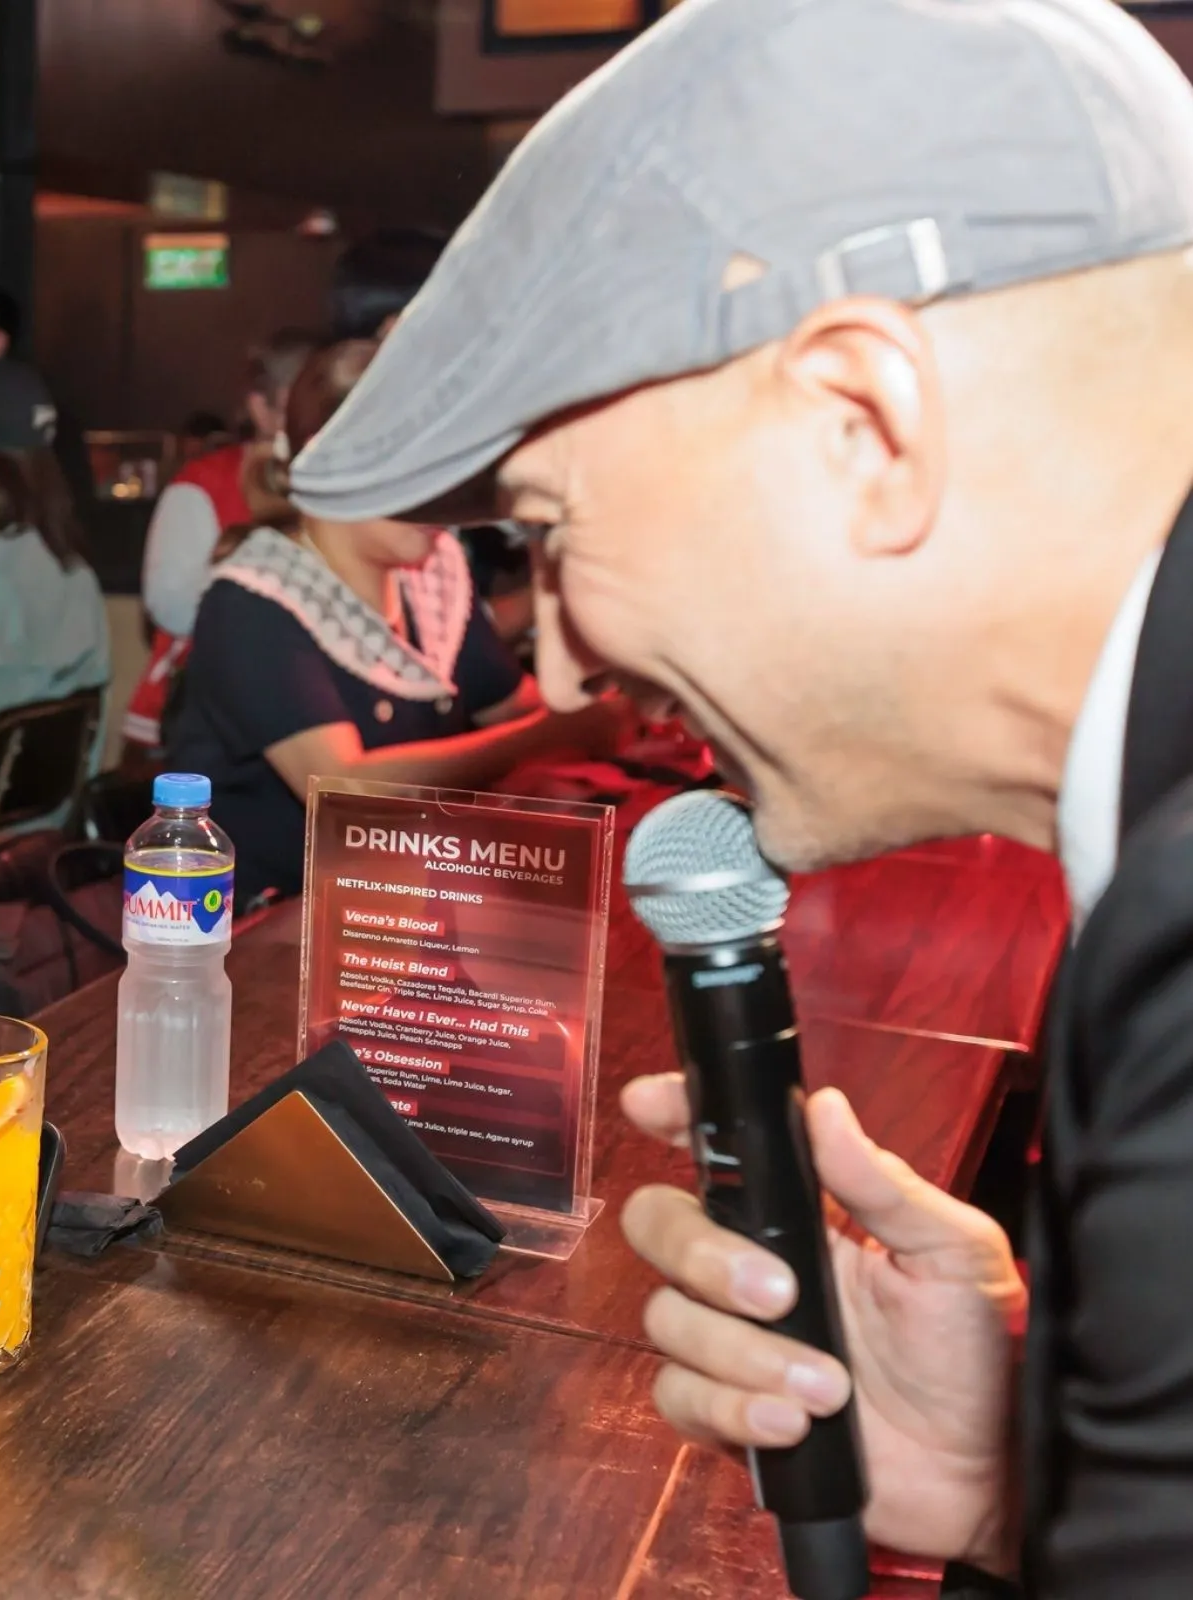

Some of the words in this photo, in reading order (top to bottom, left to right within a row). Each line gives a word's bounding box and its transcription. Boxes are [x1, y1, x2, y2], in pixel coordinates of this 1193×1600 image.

[345, 825, 461, 859] DRINKS
[470, 839, 566, 871] MENU
[425, 860, 491, 877] ALCOHOLIC
[493, 868, 564, 885] BEVERAGES
[337, 877, 437, 899] NETFLIX-INSPIRED
[440, 889, 483, 904] DRINKS
[345, 910, 395, 928] Vecna's
[398, 917, 439, 933] Blood
[342, 929, 381, 942] Disaronno
[382, 934, 418, 947] Amaretto
[419, 939, 451, 952] Liqueur,
[452, 944, 480, 955] Lemon
[344, 953, 368, 967] The
[370, 958, 405, 972] Heist
[408, 962, 448, 977] Blend
[340, 971, 369, 982] Absolut
[370, 975, 395, 986] Vodka,
[396, 978, 437, 991] Cazadores
[437, 983, 467, 996] Tequila,
[469, 989, 499, 1000] Bacardi
[500, 992, 534, 1006] Superior
[535, 998, 557, 1009] Rum,
[340, 979, 376, 991] Beefeater
[393, 986, 415, 998] Triple
[415, 990, 432, 1001] Sec,
[433, 992, 453, 1003] Lime
[453, 995, 476, 1007] Juice,
[477, 999, 501, 1011] Sugar
[528, 1006, 549, 1017] Coke
[342, 999, 381, 1016] Never
[383, 1006, 416, 1021] Have
[426, 1013, 466, 1029] Ever...
[470, 1019, 499, 1034] Had
[501, 1023, 530, 1038] This
[339, 1016, 368, 1028] Absolut
[368, 1020, 394, 1032] Vodka,
[395, 1023, 434, 1038] Cranberry
[434, 1029, 457, 1041] Juice,
[458, 1033, 487, 1046] Orange
[487, 1037, 511, 1049] Juice,
[339, 1023, 375, 1038] Pineapple
[376, 1029, 399, 1041] Juice,
[400, 1033, 423, 1044] Peach
[424, 1036, 463, 1051] Schnapps
[355, 1047, 372, 1059] e's
[374, 1050, 443, 1071] Obsession
[366, 1066, 398, 1079] Superior
[399, 1071, 420, 1082] Rum,
[421, 1074, 442, 1086] Lime,
[443, 1077, 463, 1088] Lime
[464, 1081, 487, 1093] Juice,
[487, 1084, 513, 1097] Sugar,
[383, 1077, 402, 1087] Soda
[403, 1080, 427, 1091] Water
[391, 1099, 412, 1112] ate
[424, 1121, 447, 1133] Juice,
[447, 1125, 470, 1138] triple
[469, 1130, 485, 1140] sec,
[486, 1133, 510, 1144] Agave
[511, 1137, 535, 1149] syrup
